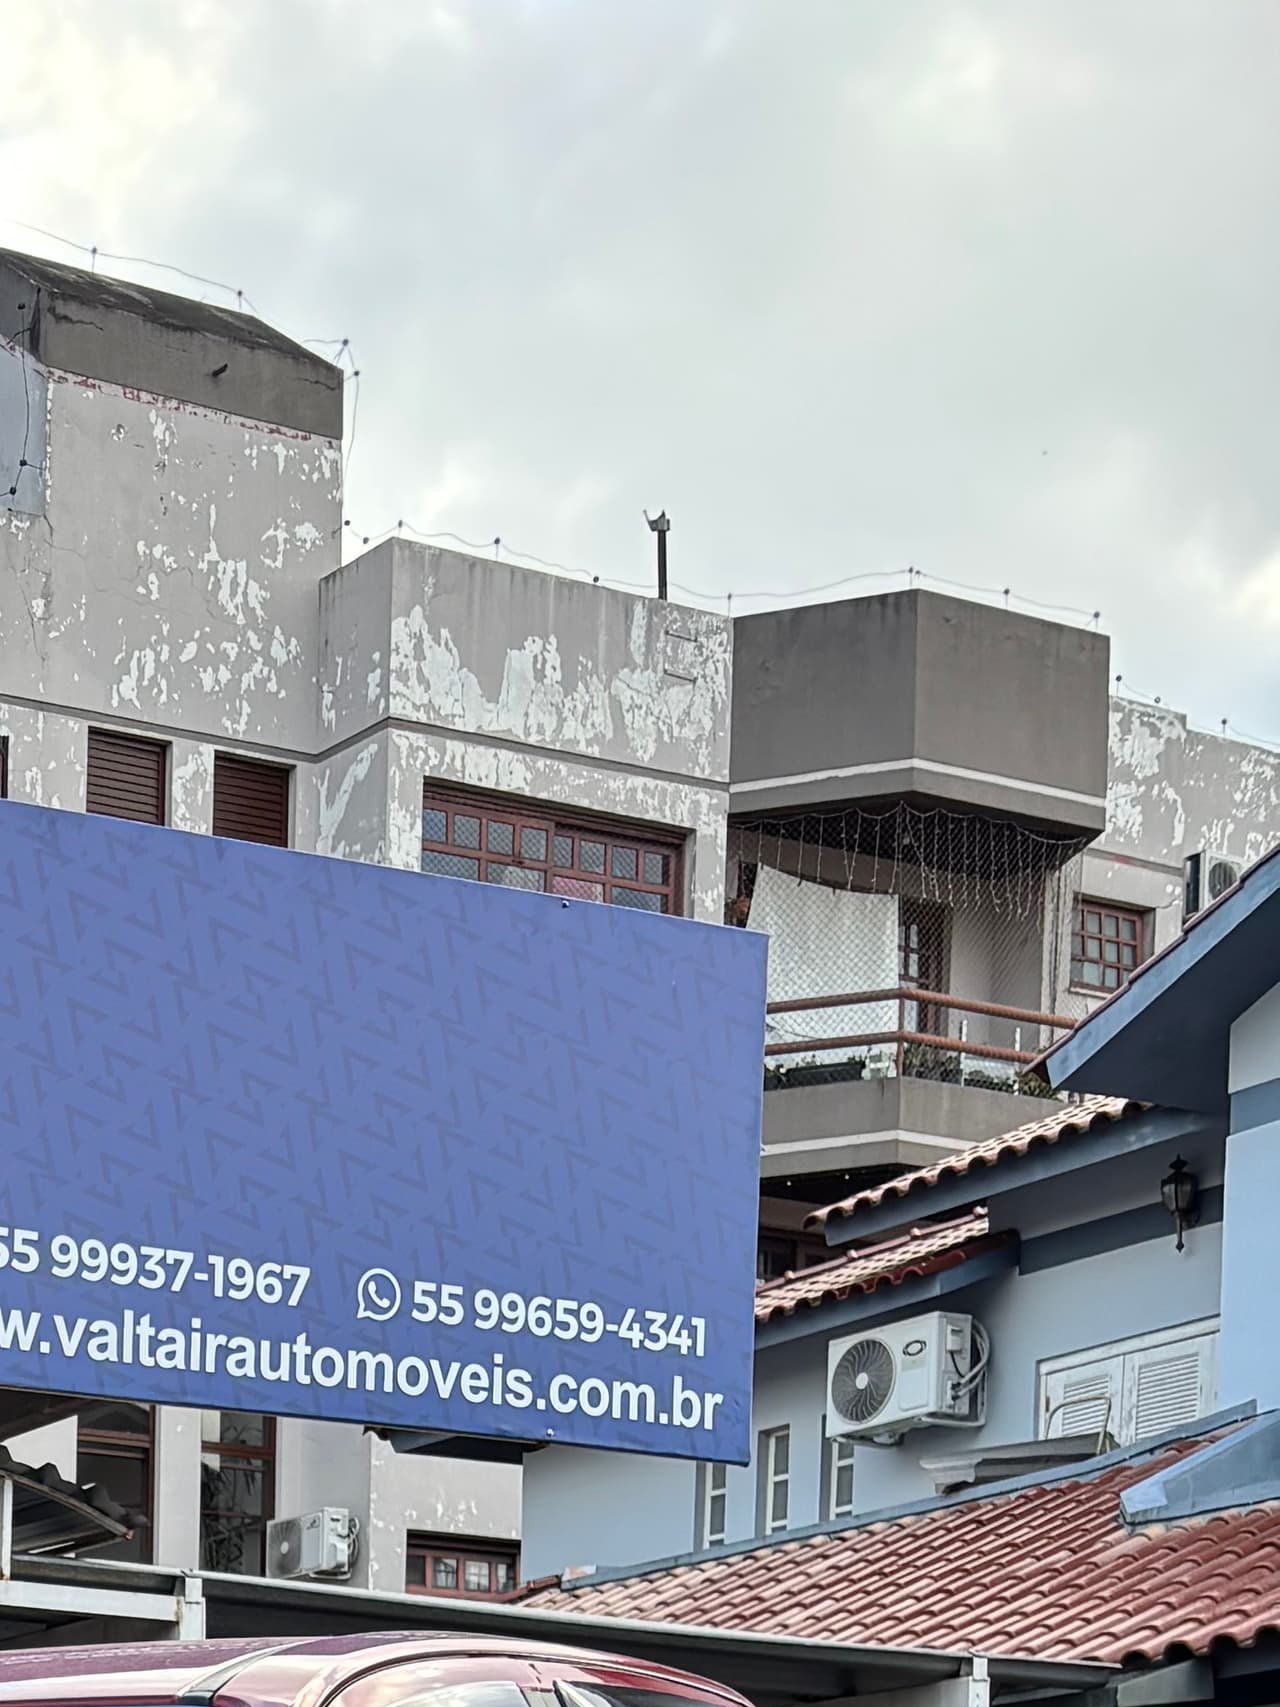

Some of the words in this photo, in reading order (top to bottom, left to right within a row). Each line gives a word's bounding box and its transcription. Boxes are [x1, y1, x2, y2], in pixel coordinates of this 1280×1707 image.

[51, 1234, 311, 1308] 99937-1967
[412, 1281, 465, 1325] 55
[475, 1288, 708, 1358] 99659-4341
